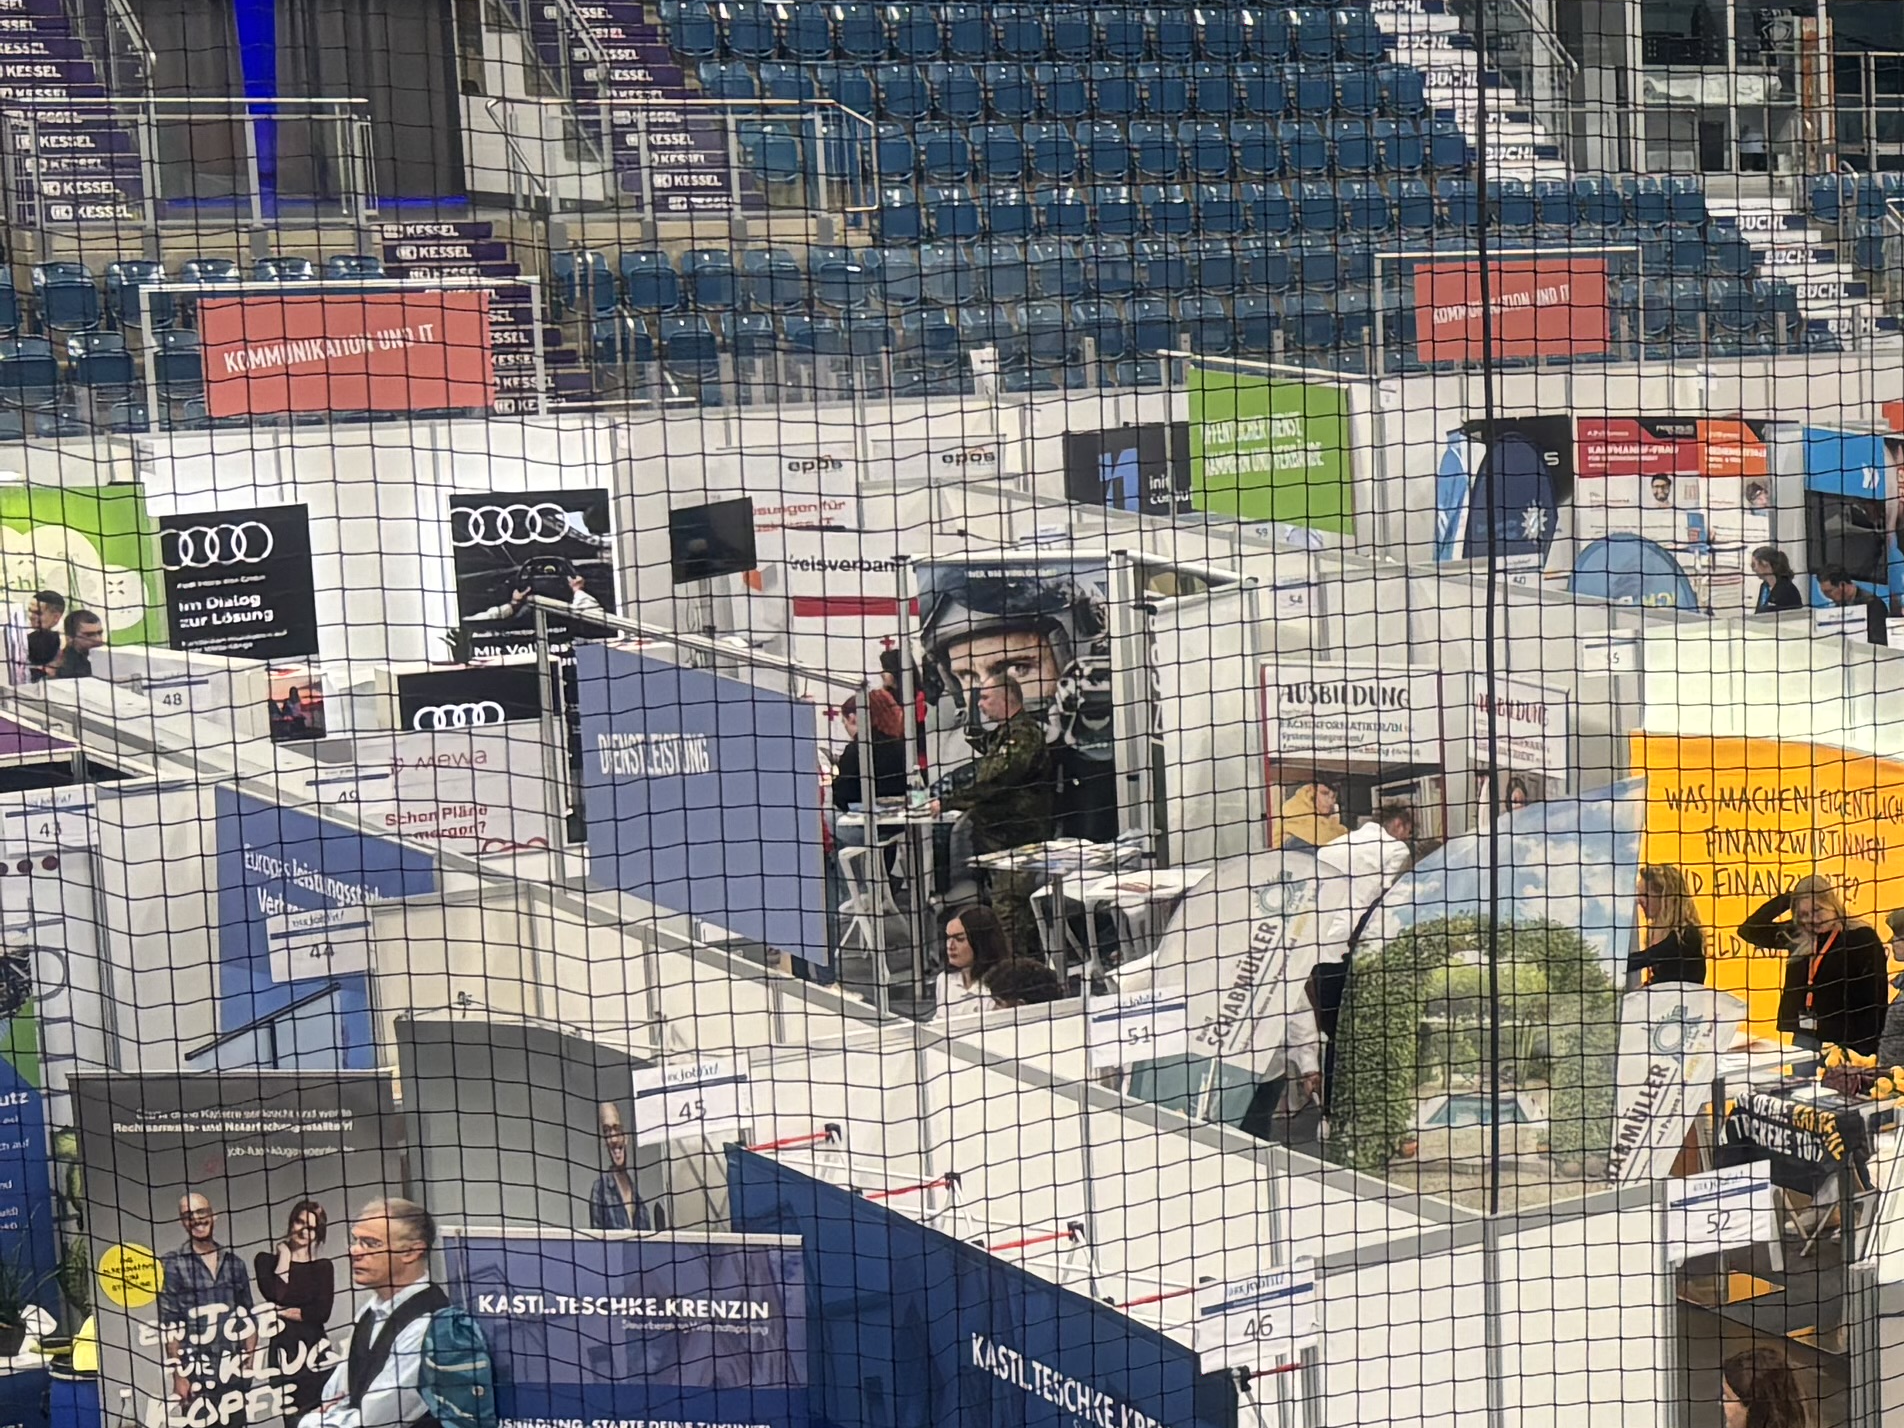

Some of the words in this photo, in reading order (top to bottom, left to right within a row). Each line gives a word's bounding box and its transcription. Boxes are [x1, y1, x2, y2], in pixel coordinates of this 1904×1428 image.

[222, 332, 374, 373] KOMMUNIKATION
[418, 323, 436, 345] IT
[206, 593, 261, 609] Dialog
[1280, 683, 1409, 707] AUSBILDUNG
[598, 731, 708, 775] DIENSTLEISTUNG
[1665, 784, 1707, 814] WAS
[1719, 784, 1809, 814] MACHEN
[1820, 788, 1904, 824] EIGENTLICH
[1208, 921, 1278, 1048] SCHABMÜLLER
[1127, 1024, 1152, 1046] 51
[677, 1098, 706, 1121] 45
[478, 1294, 769, 1319] KASTL.TESCHKE.KRENZIN
[188, 1302, 285, 1346] JOB
[1244, 1313, 1275, 1341] 46
